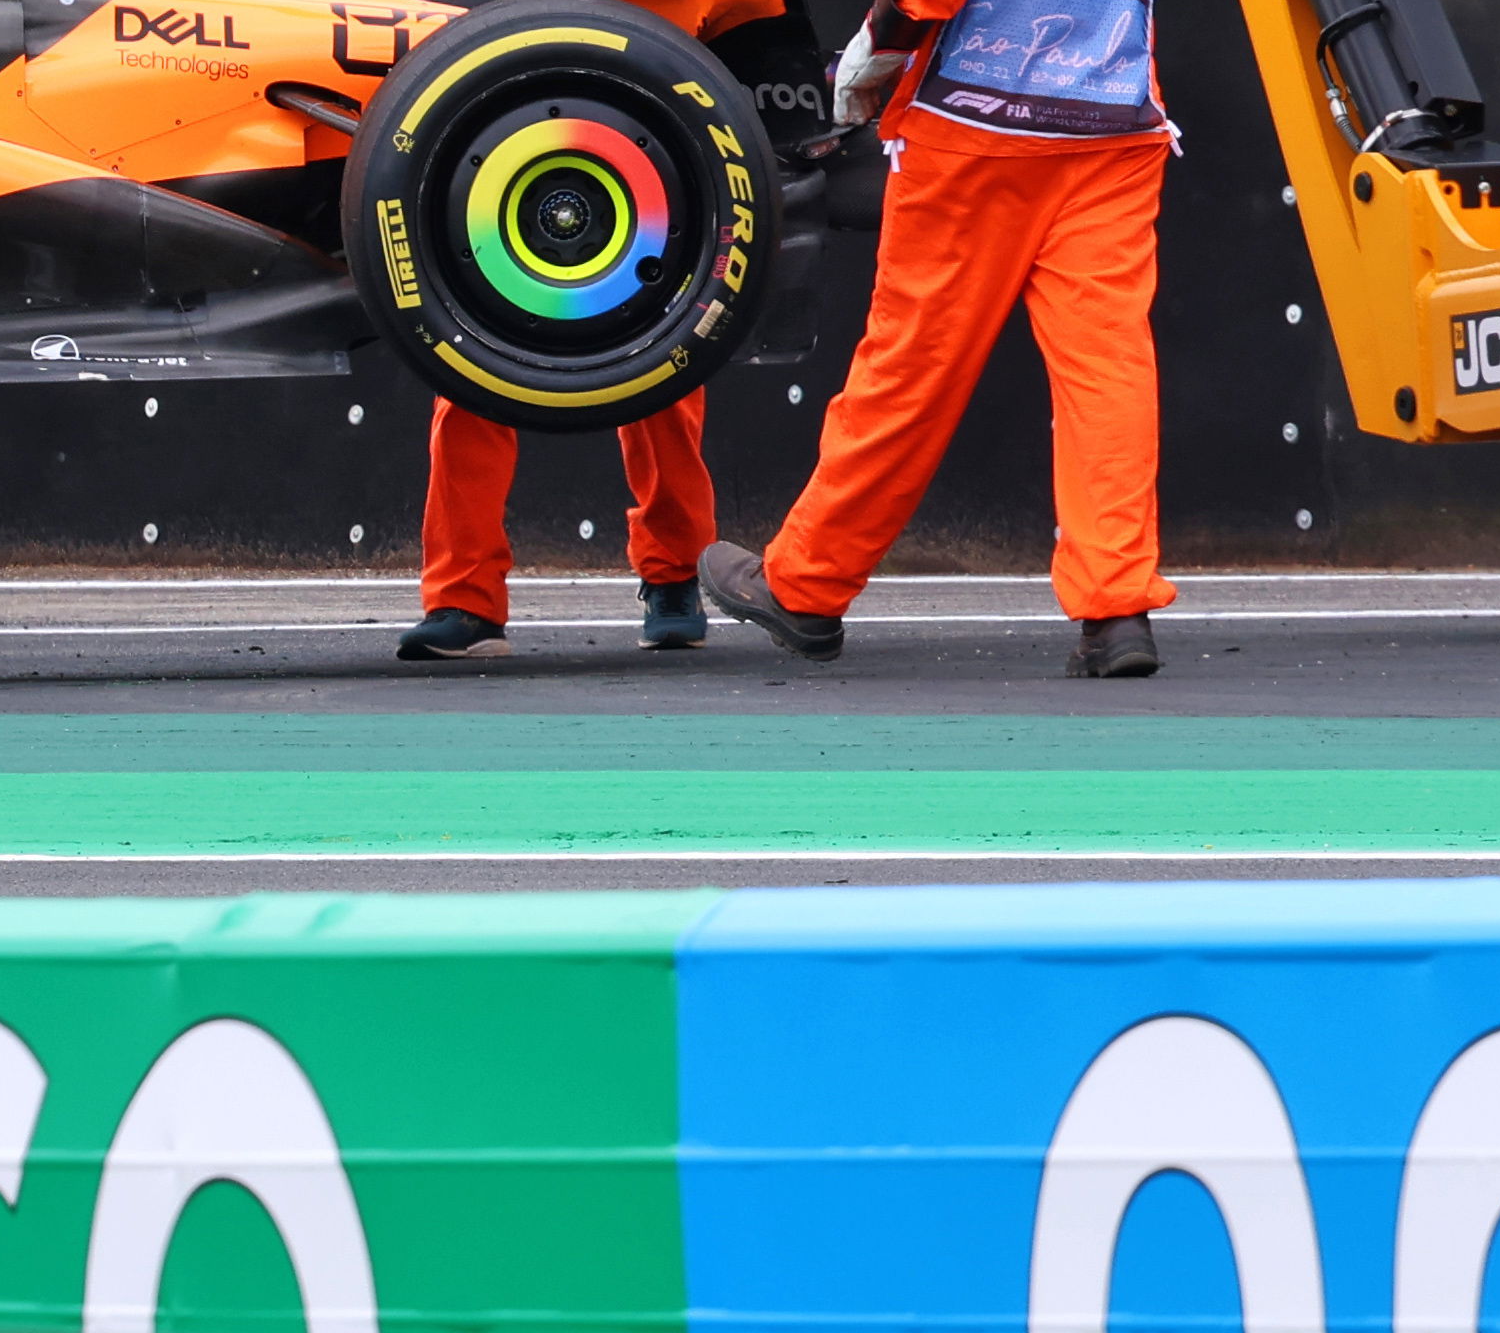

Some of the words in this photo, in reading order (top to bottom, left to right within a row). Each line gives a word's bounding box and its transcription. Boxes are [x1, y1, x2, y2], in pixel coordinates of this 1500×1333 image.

[115, 5, 250, 50] DELL
[115, 48, 249, 81] Technologies
[755, 83, 826, 121] roq
[672, 81, 715, 108] P
[707, 124, 755, 293] ZERO
[376, 199, 422, 309] PIRELLI
